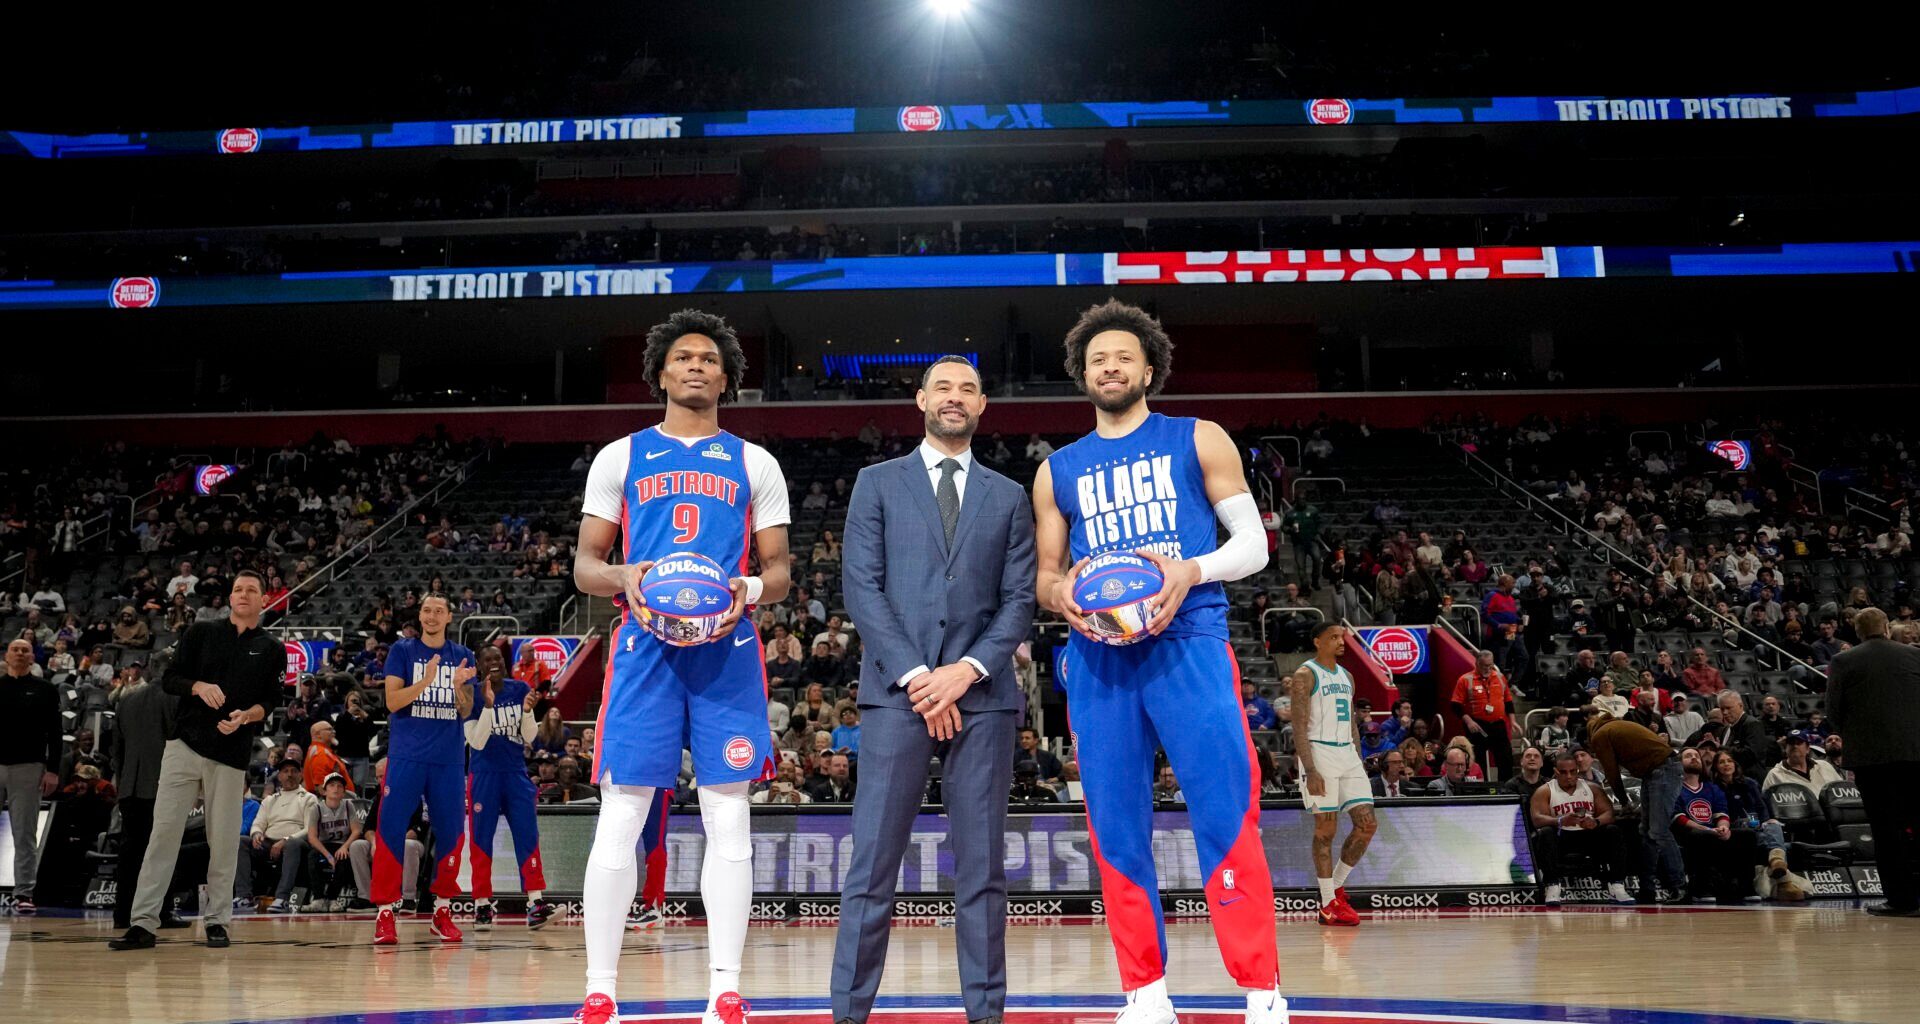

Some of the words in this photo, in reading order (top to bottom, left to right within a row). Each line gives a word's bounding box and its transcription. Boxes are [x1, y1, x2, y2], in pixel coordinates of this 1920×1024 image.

[1554, 99, 1670, 121] DETROIT
[1681, 97, 1792, 119] PISTONS
[451, 120, 564, 145] DETROIT
[574, 116, 683, 141] PISTONS
[390, 271, 528, 300] DETROIT
[541, 268, 675, 297] PISTONS
[634, 470, 740, 508] DETROIT
[1077, 454, 1178, 520] BLACK
[672, 503, 700, 544] 9
[1085, 500, 1178, 550] HISTORY
[657, 559, 721, 581] Wilson
[1080, 555, 1144, 579] Wilson
[1378, 642, 1411, 651] DETROIT
[534, 650, 561, 660] ETROIT
[1377, 651, 1413, 660] PISTONS
[411, 705, 436, 719] BLACK
[1335, 698, 1350, 721] 3
[1772, 791, 1807, 804] UWM
[1564, 876, 1602, 890] Little
[1805, 869, 1843, 884] Little
[1175, 898, 1208, 914] Sto
[1274, 896, 1320, 911] Stoc
[1370, 893, 1439, 908] StockX
[1467, 890, 1536, 906] StockX
[799, 901, 841, 916] Stoc
[1007, 900, 1063, 914] tockX
